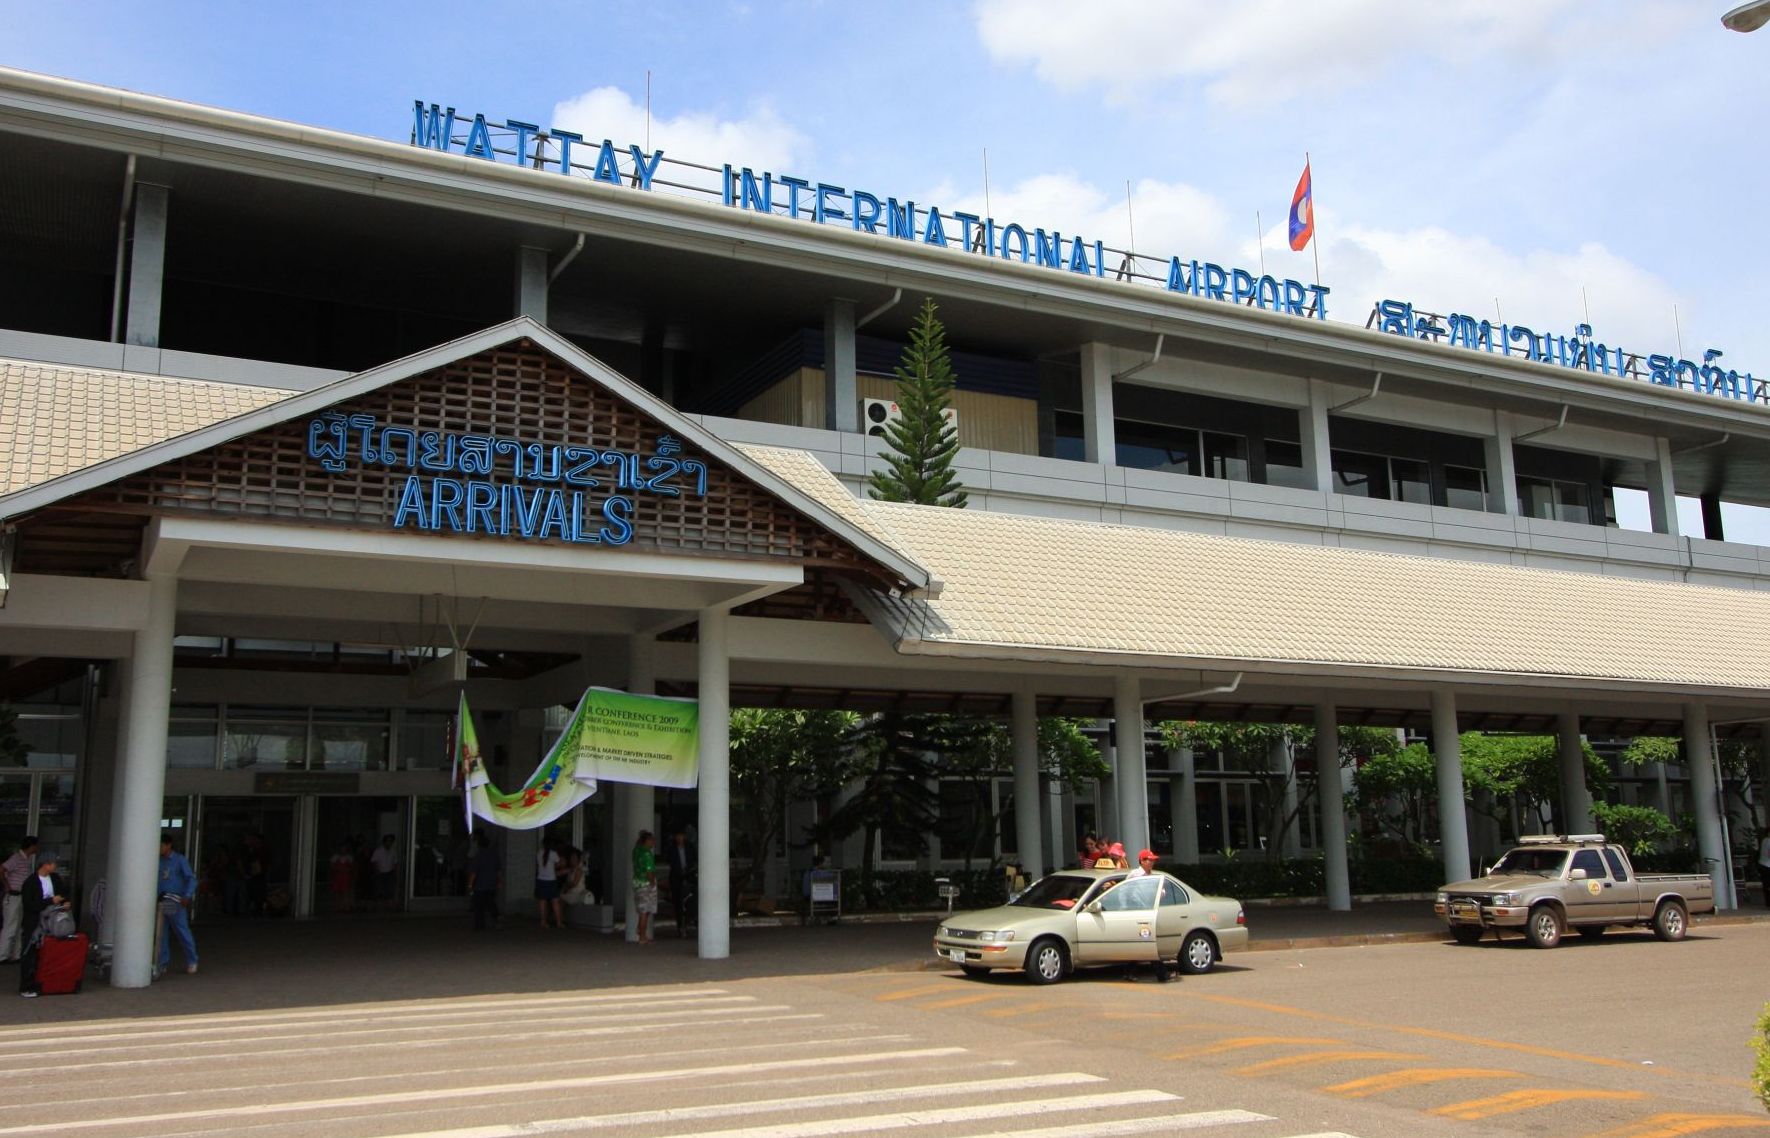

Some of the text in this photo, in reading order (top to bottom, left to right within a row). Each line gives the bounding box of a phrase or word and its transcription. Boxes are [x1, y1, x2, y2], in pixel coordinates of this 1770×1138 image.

[414, 100, 1331, 320] WATTAY INTERNATIONAL AIRPORT
[394, 475, 633, 545] ARRIVALS
[596, 707, 657, 723] CONFERENCE
[659, 715, 679, 725] 2009
[602, 747, 623, 755] MARKET
[623, 750, 643, 758] DRIVEN
